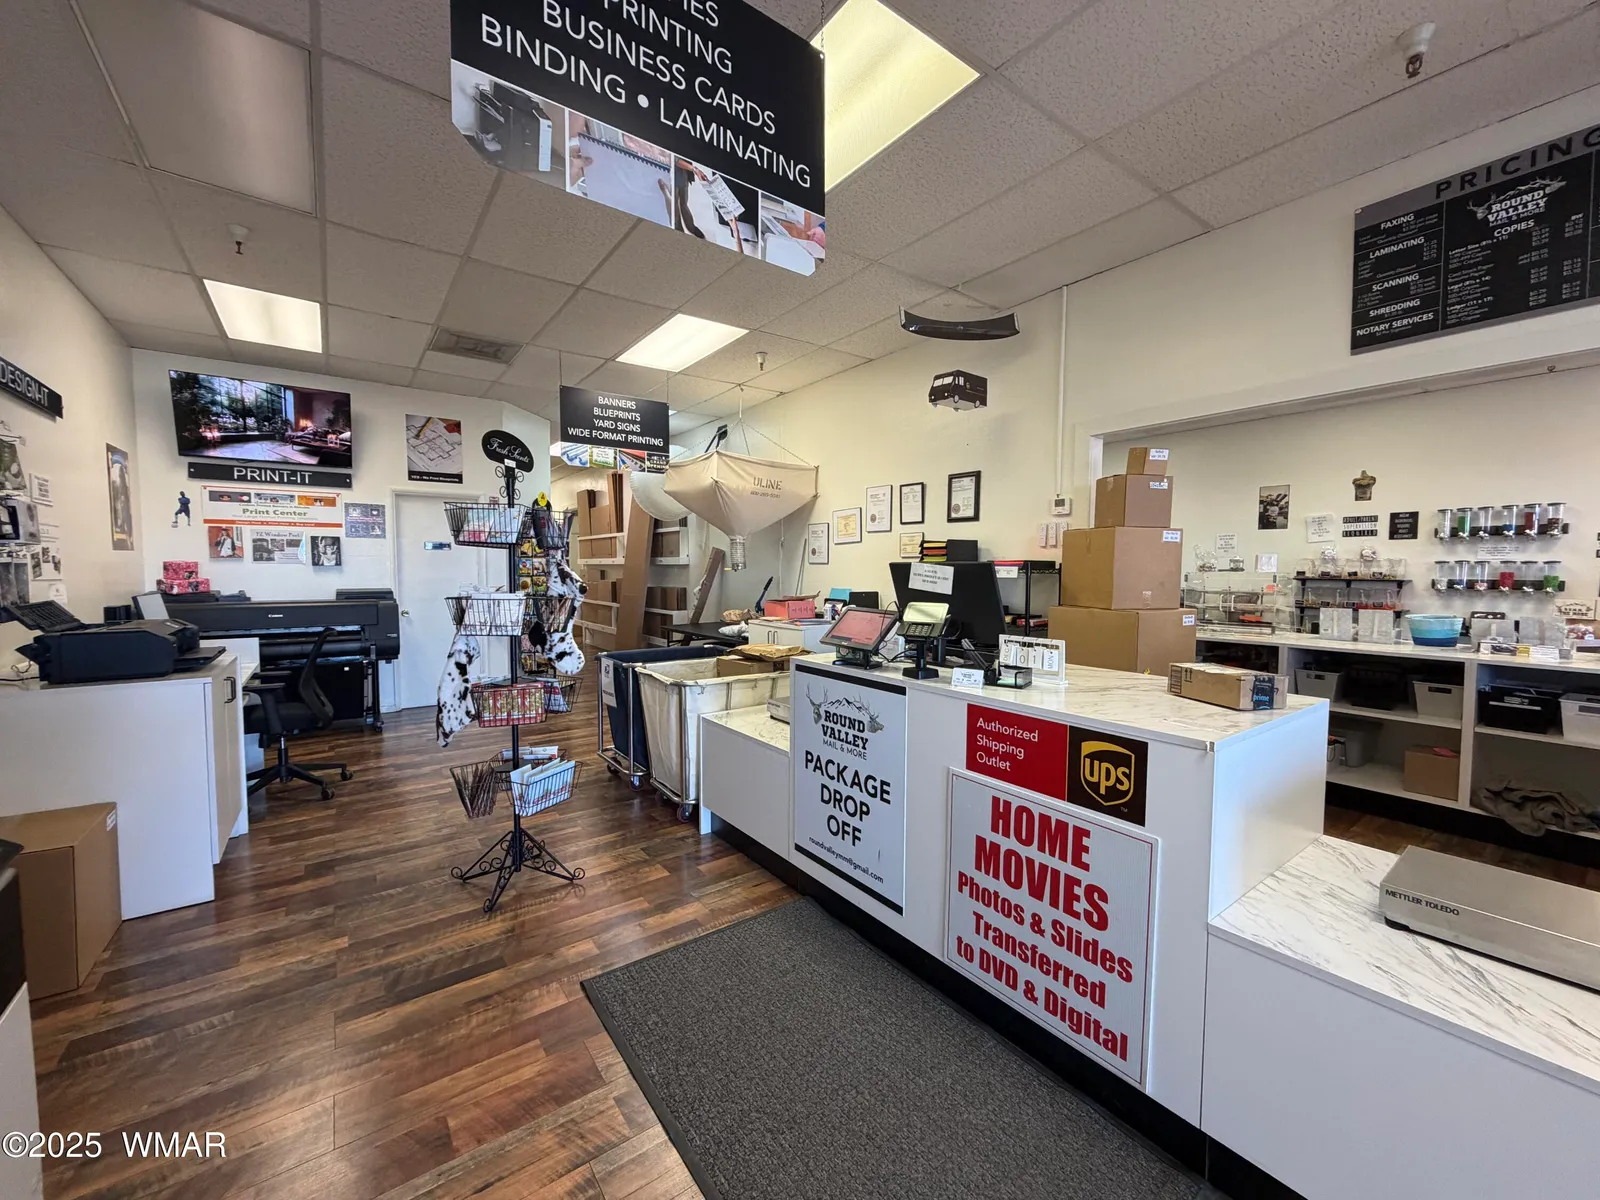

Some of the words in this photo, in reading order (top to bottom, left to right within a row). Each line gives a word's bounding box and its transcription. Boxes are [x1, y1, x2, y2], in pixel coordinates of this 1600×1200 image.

[543, 0, 686, 90] BUSINESS
[694, 77, 776, 135] CARDS
[481, 14, 626, 104] BINDING
[661, 98, 811, 189] LAMINATING
[1487, 197, 1548, 222] VALLEY
[1491, 189, 1544, 213] ROUND
[1380, 213, 1414, 230] FAXING
[1494, 219, 1535, 236] COPIES
[1369, 236, 1425, 259] LAMINATING
[1372, 273, 1419, 292] SCANNING
[1369, 298, 1420, 317] SHREDDING
[1356, 322, 1390, 336] NOTARY
[1392, 312, 1434, 328] SERVICES
[0, 361, 49, 406] DESIGN-IT
[593, 407, 641, 421] BLUEPRINTS
[598, 396, 636, 409] BANNERS
[568, 427, 591, 438] WIDE
[592, 430, 626, 442] FORMAT
[627, 435, 664, 447] PRINTING
[593, 419, 615, 429] YARD
[617, 422, 641, 433] SIGNS
[233, 467, 312, 484] PRINT-IT
[753, 476, 783, 491] ULINE
[273, 509, 308, 517] Center
[824, 709, 865, 733] ROUND
[976, 717, 1038, 742] Authorized
[821, 724, 868, 750] VALLEY
[976, 734, 1025, 760] Shipping
[823, 739, 838, 750] MAIL
[840, 743, 845, 752] &
[846, 747, 868, 761] MORE
[976, 752, 1011, 771] Outlet
[805, 749, 891, 805] PACKAGE
[1084, 757, 1130, 795] ups
[820, 782, 871, 822] DROP
[827, 814, 862, 847] OFF
[990, 795, 1091, 872] HOME
[808, 836, 884, 884] roundvalleymm@gmail.com
[974, 834, 1109, 932] MOVIES
[1385, 888, 1423, 906] METTLER
[1424, 899, 1460, 916] TOLEDO
[958, 870, 1025, 926] Photos
[1030, 911, 1046, 939] &
[1051, 916, 1133, 983] Slides
[973, 910, 1106, 1009] Transferred
[956, 935, 974, 965] to
[979, 954, 1018, 991] DVD
[1023, 980, 1039, 1005] &
[1044, 987, 1128, 1063] Digital
